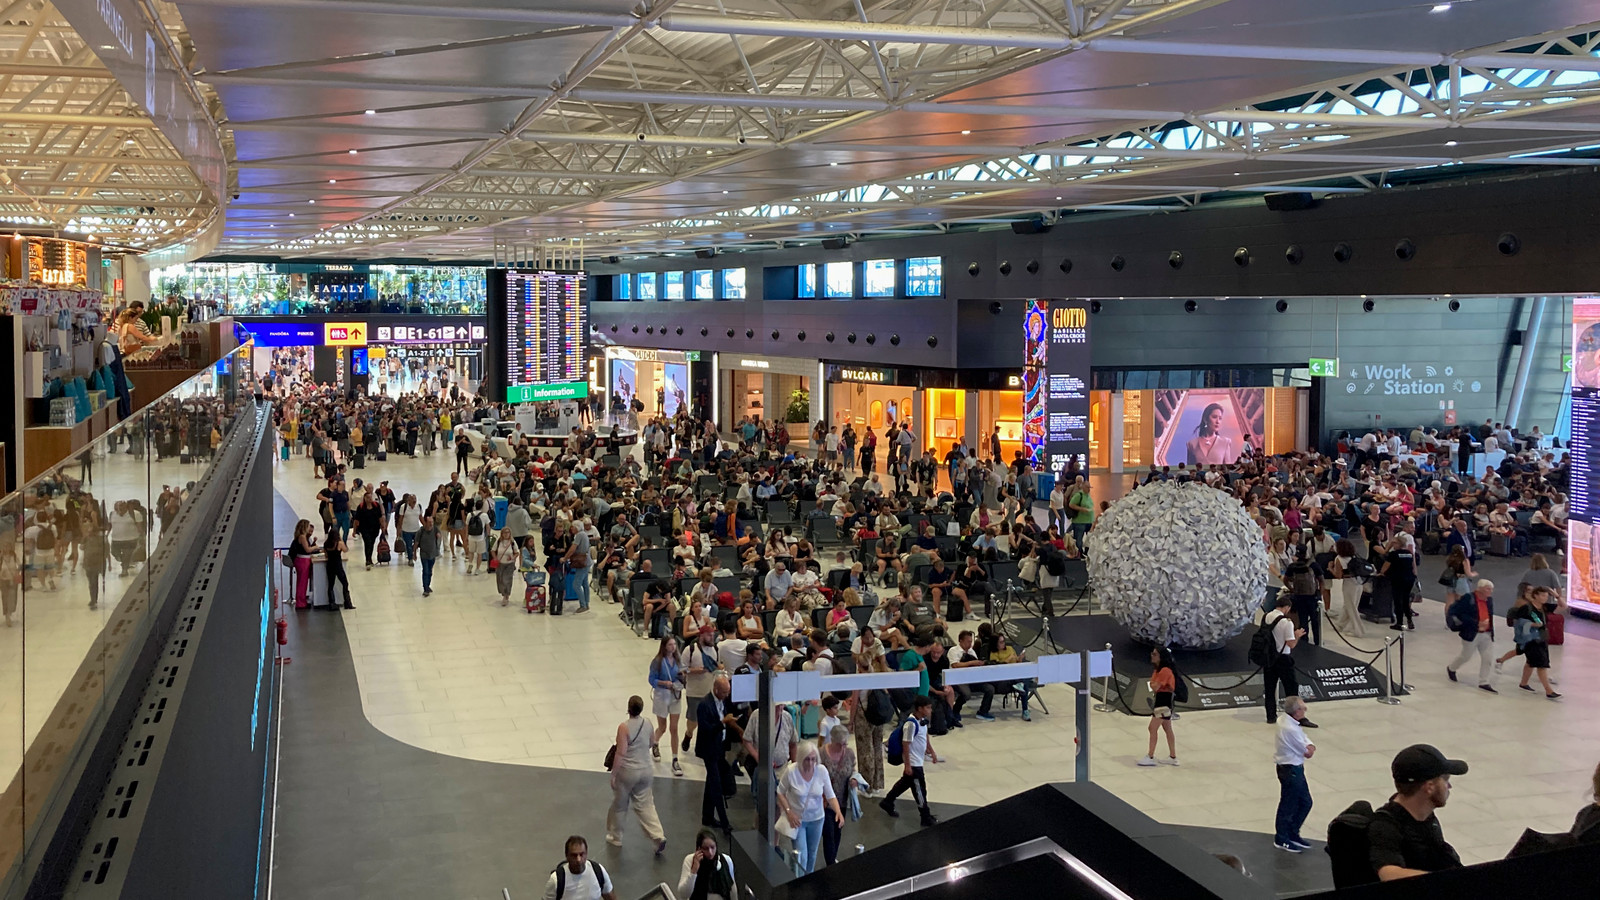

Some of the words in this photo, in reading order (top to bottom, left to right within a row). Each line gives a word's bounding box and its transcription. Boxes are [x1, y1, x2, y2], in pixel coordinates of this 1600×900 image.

[314, 284, 365, 293] EATALY
[1053, 308, 1086, 328] GIOTTO
[408, 328, 443, 340] E1-61
[842, 369, 884, 382] BVLGARI
[1365, 364, 1412, 380] Work
[534, 387, 575, 399] Information
[1384, 379, 1445, 395] Station
[1051, 453, 1085, 462] PILLS
[1316, 668, 1354, 678] MASTER
